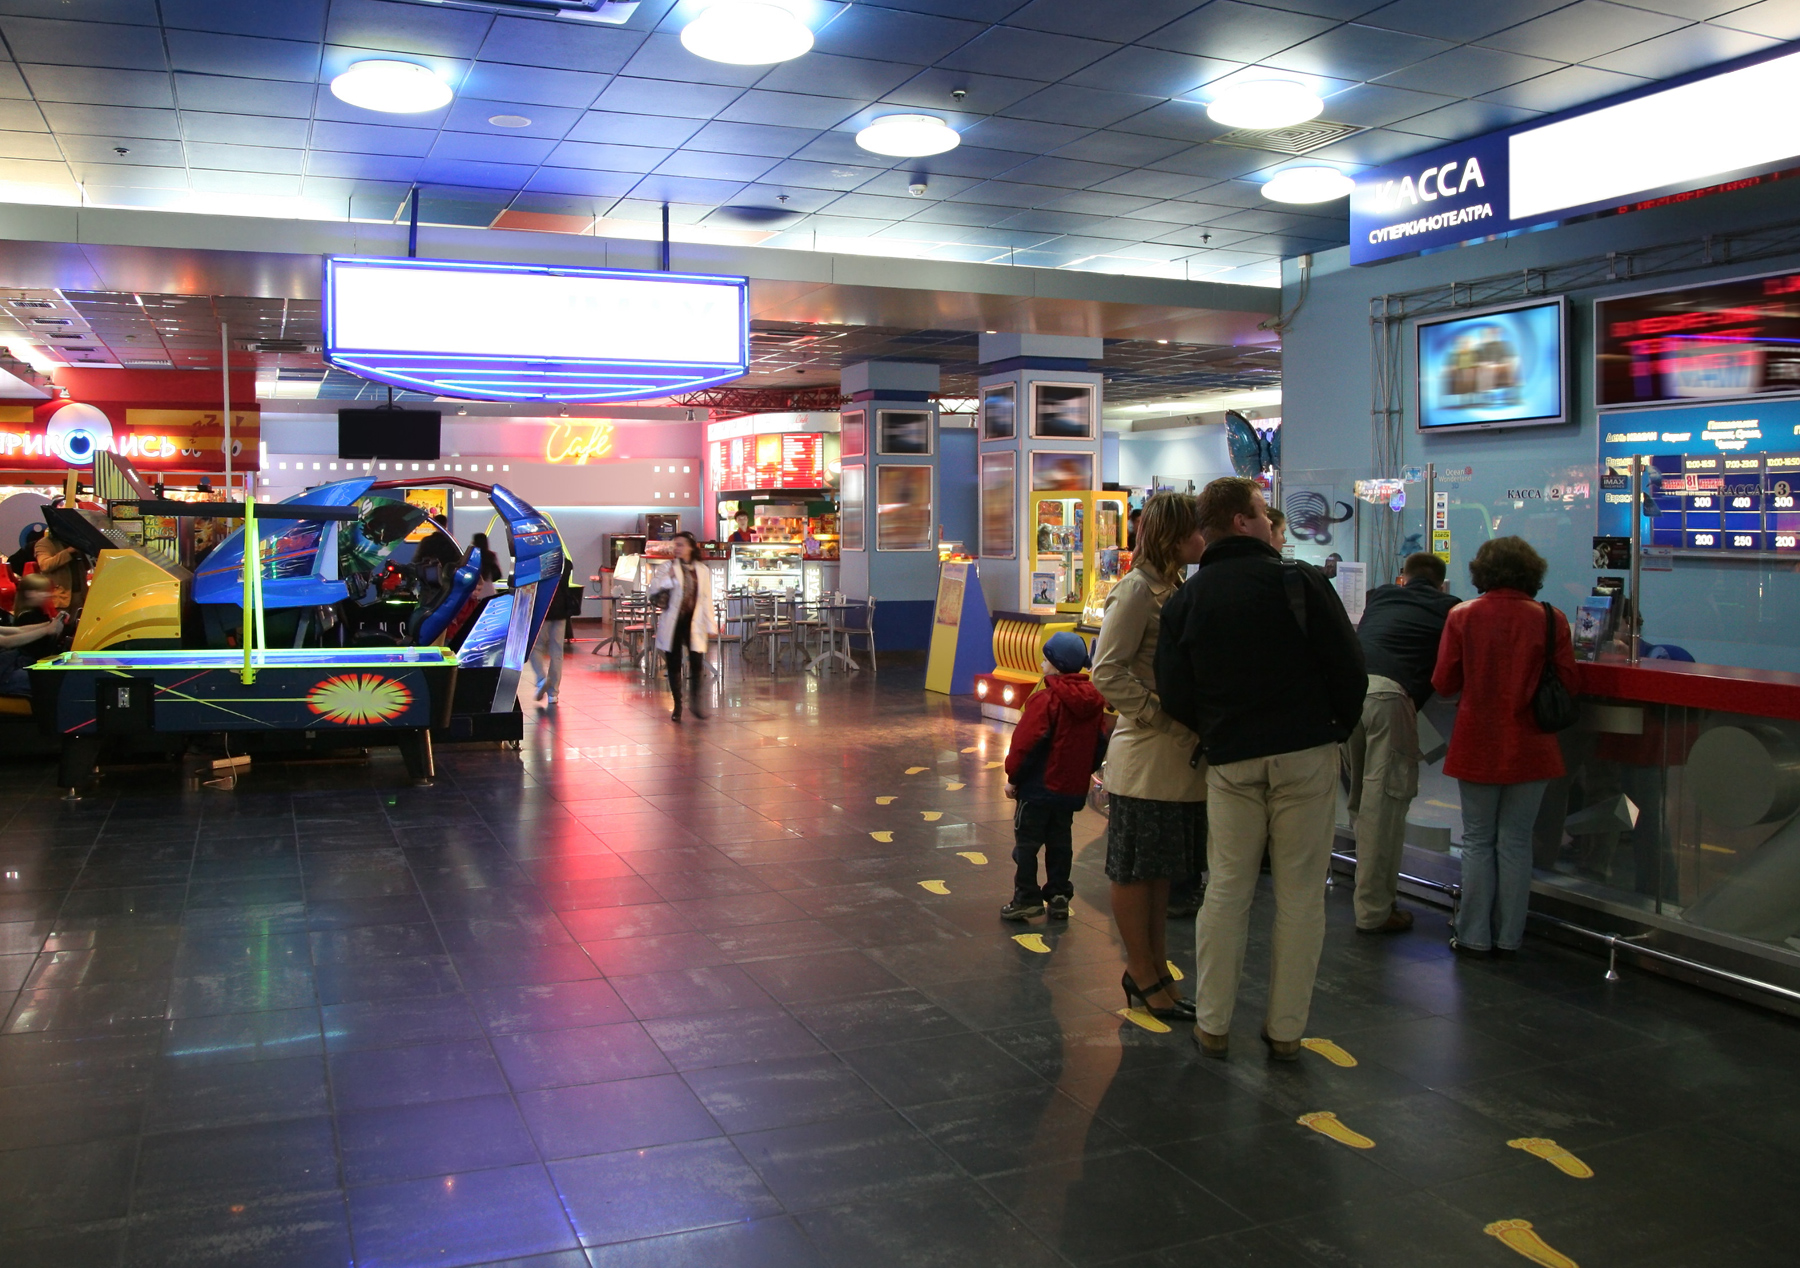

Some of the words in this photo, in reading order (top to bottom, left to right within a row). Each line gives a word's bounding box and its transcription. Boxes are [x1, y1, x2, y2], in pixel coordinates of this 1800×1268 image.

[1374, 157, 1485, 214] КАССА
[1368, 203, 1493, 245] СУПЕРКИНОТЕАТРА
[546, 425, 614, 465] Café
[1438, 475, 1472, 483] Wonderland
[1507, 489, 1541, 499] КАССА
[1551, 488, 1560, 499] 2
[1716, 484, 1763, 496] КАССА
[1777, 483, 1787, 496] 3
[1693, 497, 1712, 508] 300
[1732, 497, 1751, 508] 400
[1774, 497, 1794, 508] 300
[1695, 534, 1714, 546] 200
[1734, 535, 1753, 547] 250
[1775, 535, 1796, 547] 200
